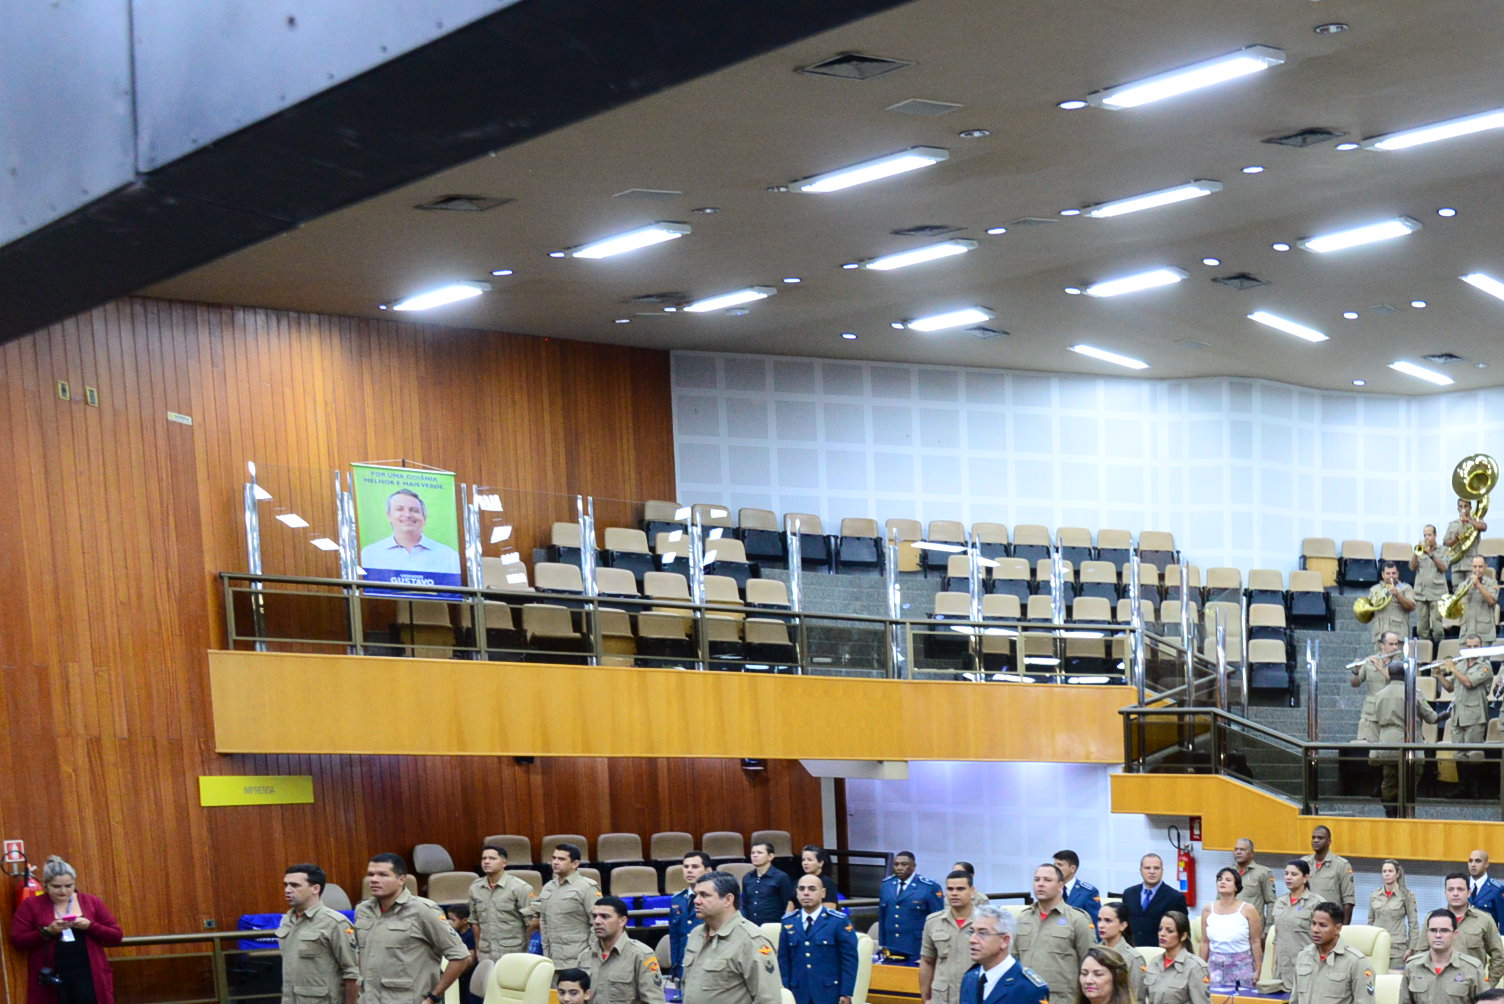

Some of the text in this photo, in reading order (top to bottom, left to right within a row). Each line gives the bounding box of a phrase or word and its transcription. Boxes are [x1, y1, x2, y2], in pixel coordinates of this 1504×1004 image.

[406, 474, 438, 482] GOIÂNIA
[390, 576, 435, 586] GUSTAVO
[244, 785, 275, 794] IMPRENSA
